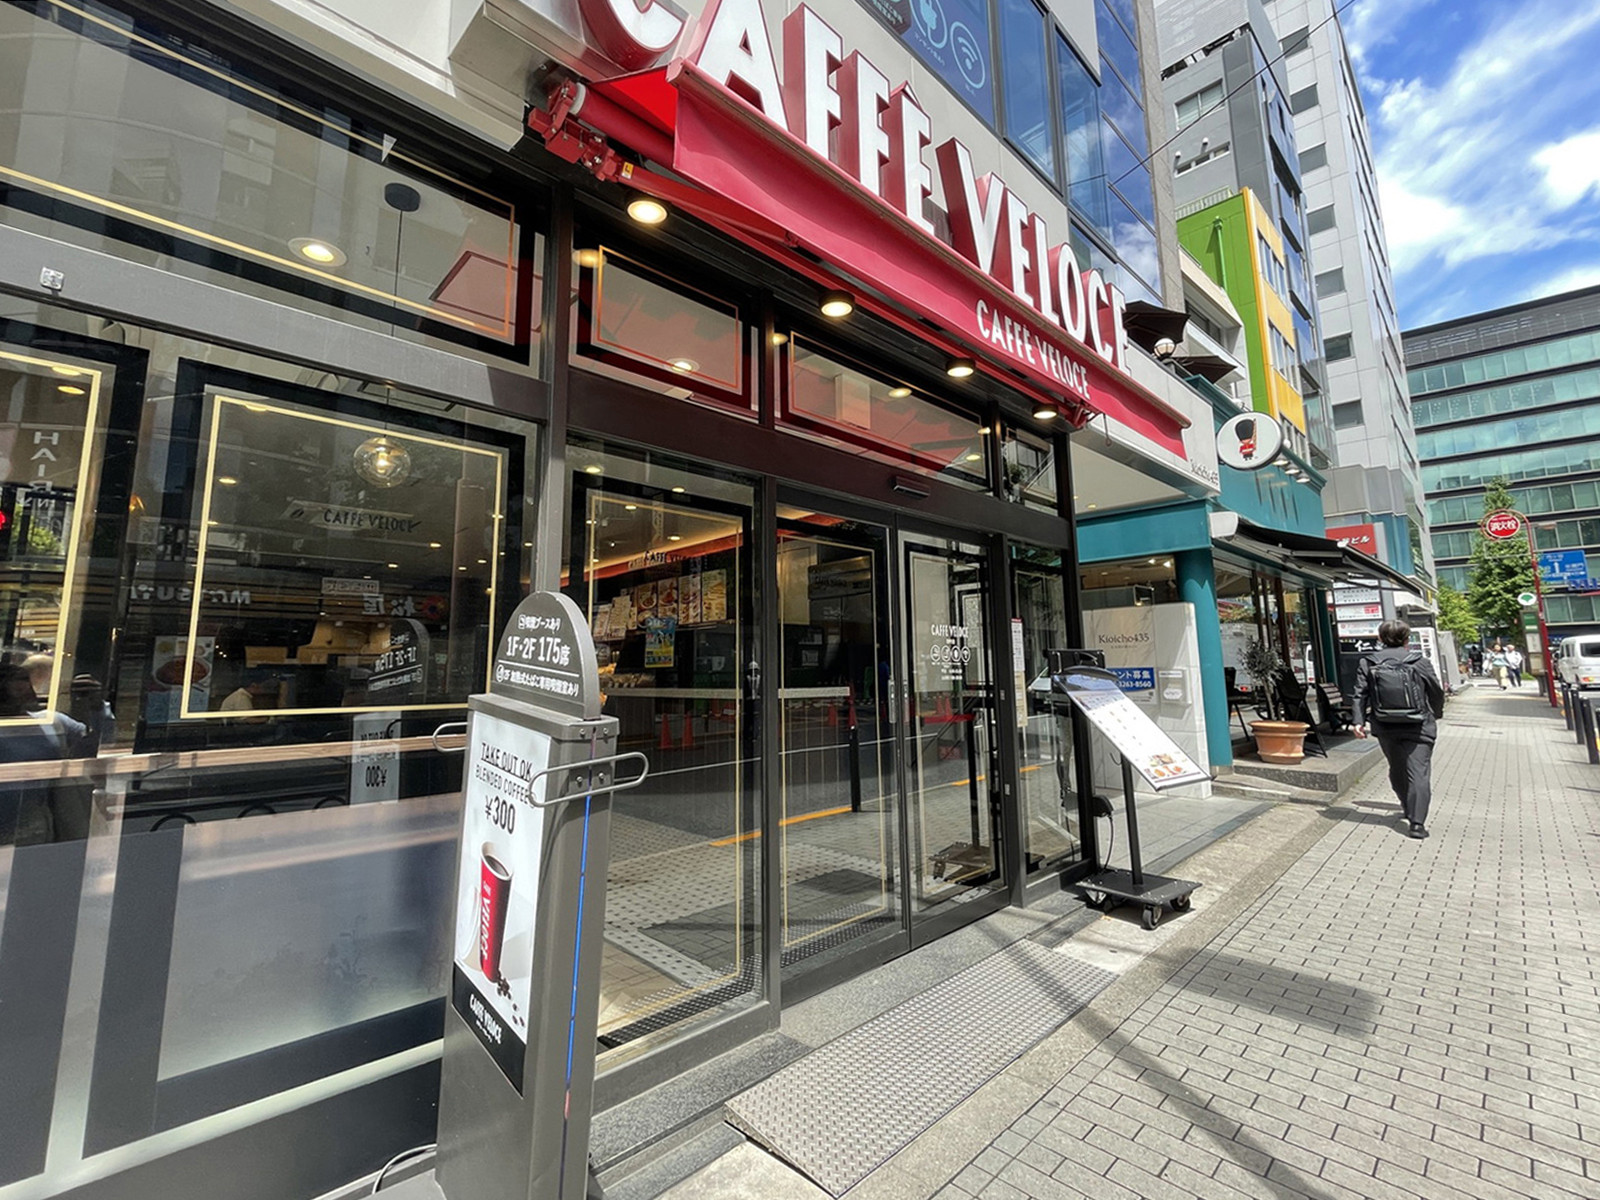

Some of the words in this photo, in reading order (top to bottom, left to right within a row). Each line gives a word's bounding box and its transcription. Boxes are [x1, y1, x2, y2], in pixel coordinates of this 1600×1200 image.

[936, 136, 1132, 378] VELOCE
[1034, 332, 1091, 400] VELOCE
[1098, 632, 1151, 644] Kioicho435
[475, 764, 503, 790] BLENDED
[481, 742, 501, 767] TAKE
[501, 751, 519, 776] OUT
[520, 759, 533, 781] OK
[485, 795, 516, 835] ¥300
